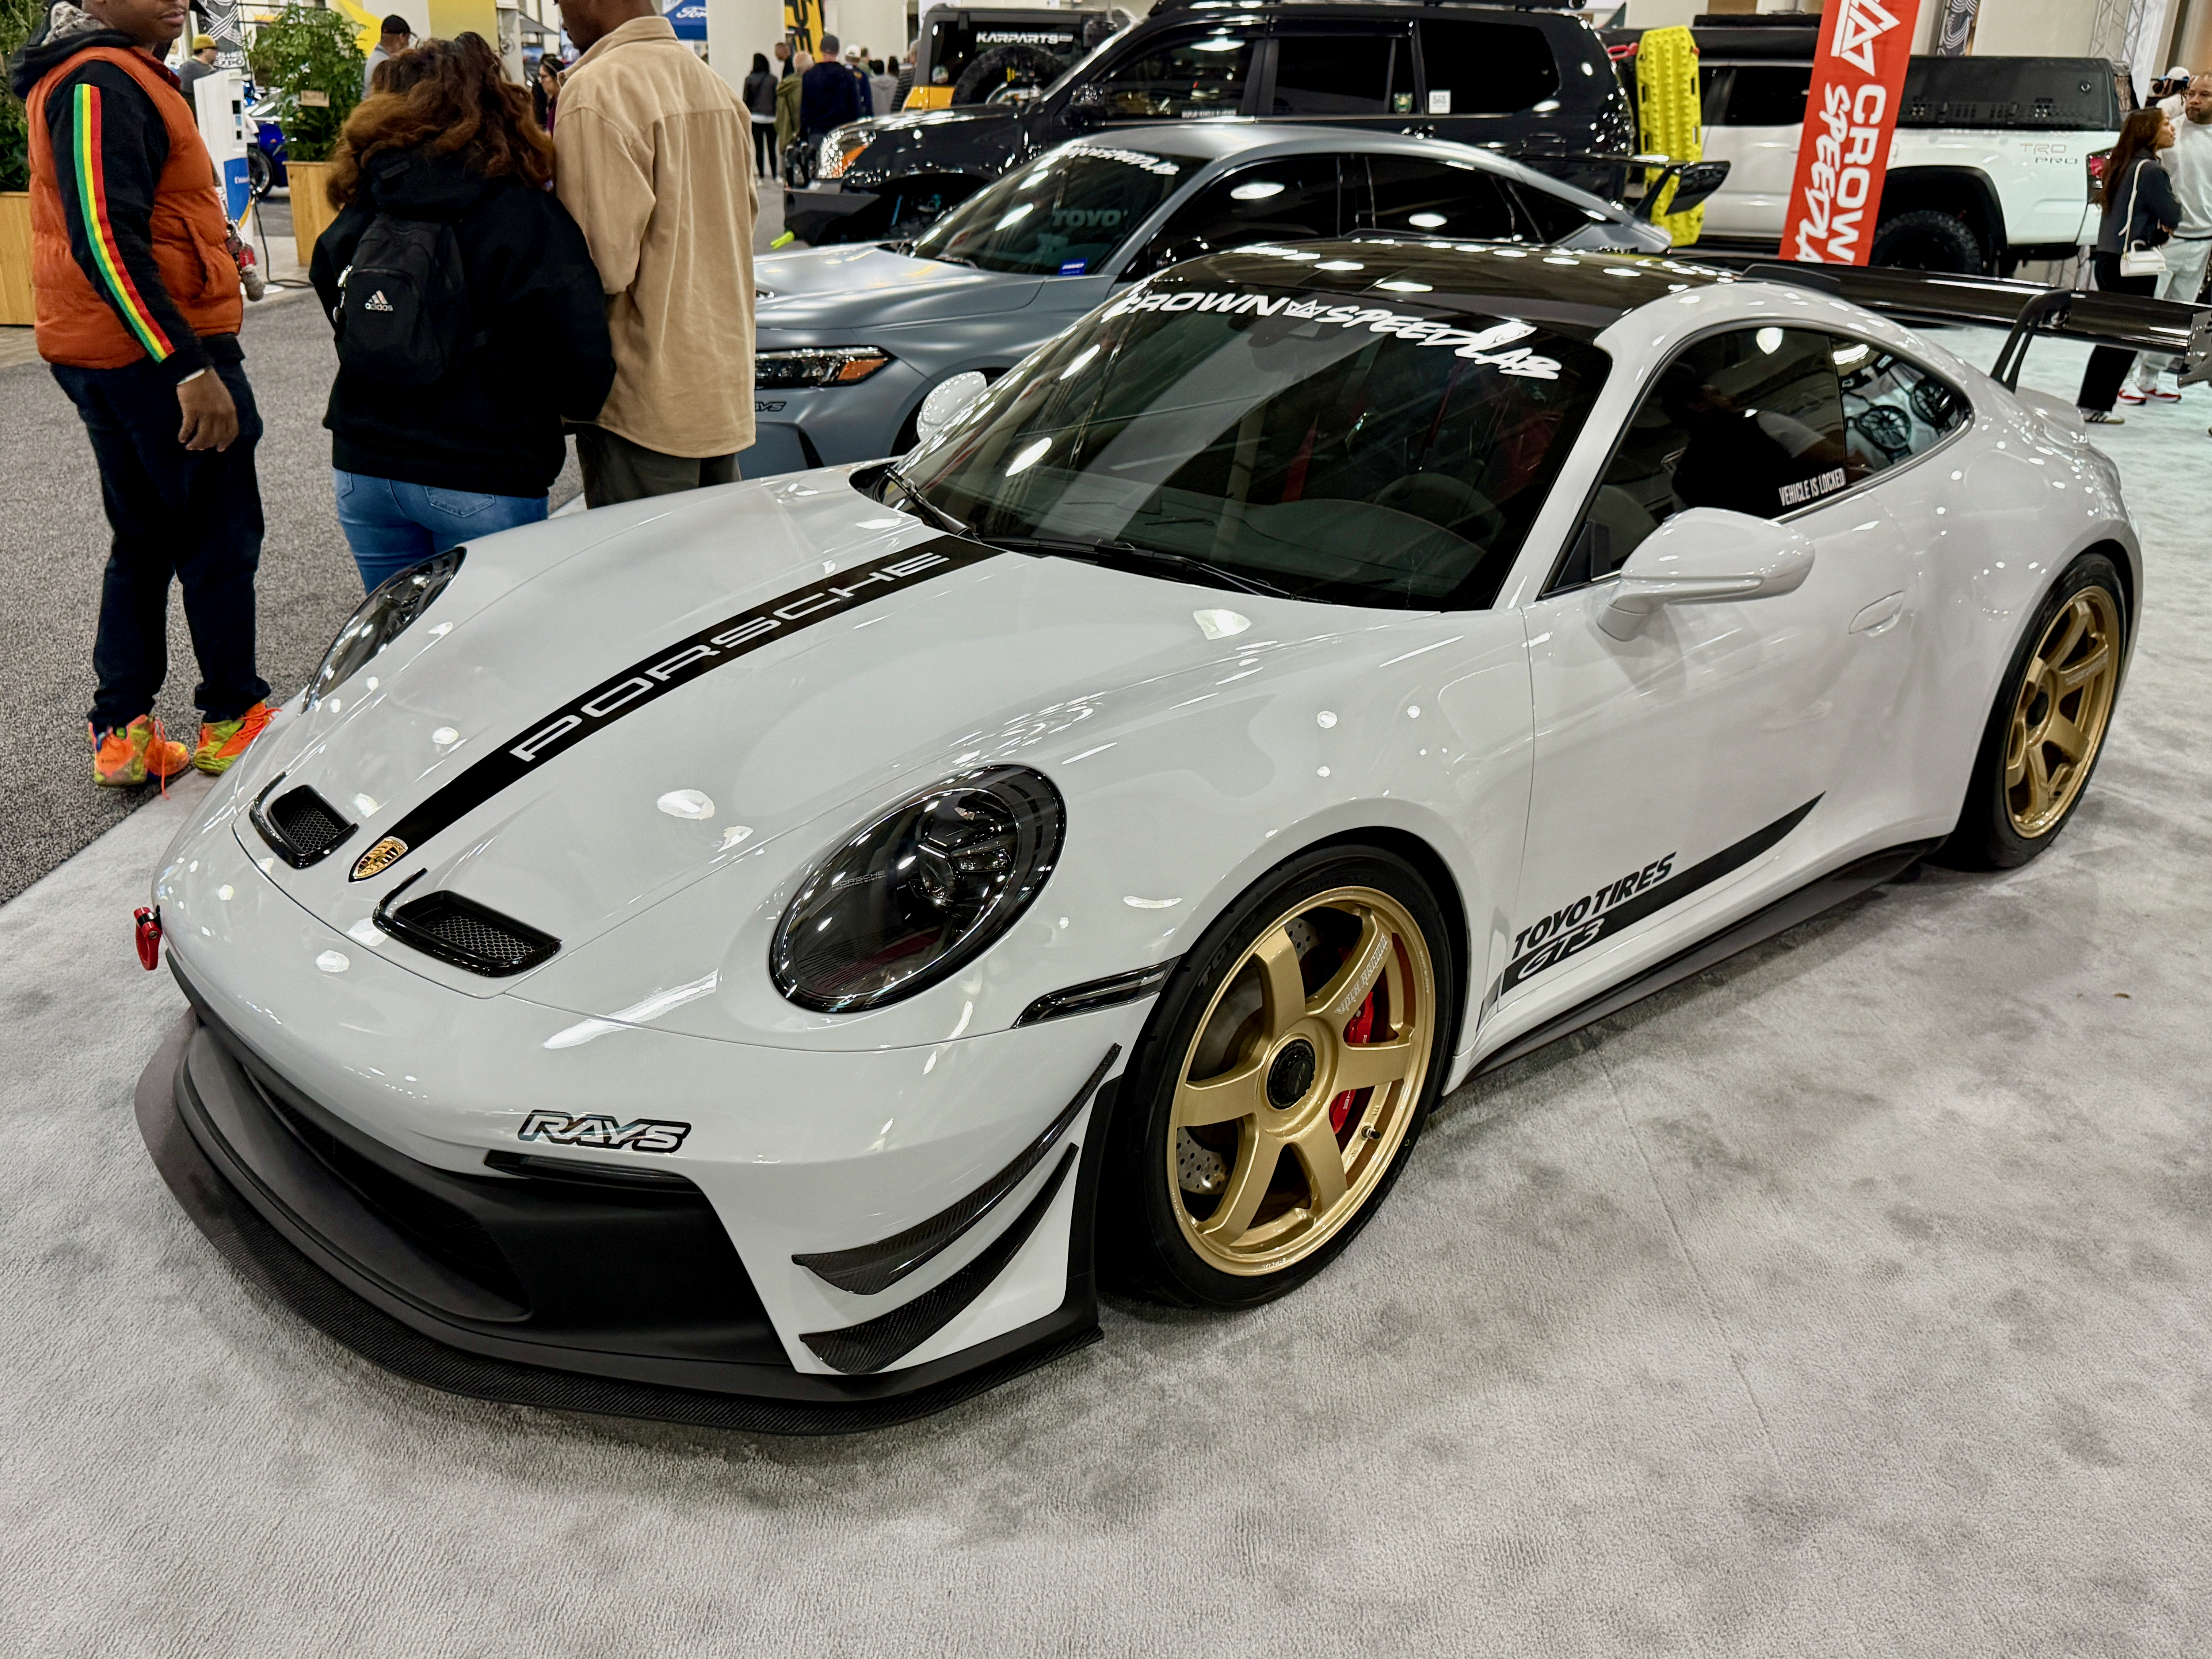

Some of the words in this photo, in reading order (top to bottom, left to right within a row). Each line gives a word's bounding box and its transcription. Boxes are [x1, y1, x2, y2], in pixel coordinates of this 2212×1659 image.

[976, 31, 1059, 45] KARPARTS
[1827, 84, 1887, 266] CROW
[1778, 480, 1811, 507] VEHICLE
[1810, 476, 1819, 498] IS
[1818, 467, 1846, 495] LOCKED
[509, 552, 950, 763] PORSCHE
[831, 870, 886, 888] PORSCHE
[1511, 895, 1592, 961] TOYO
[1591, 850, 1677, 916] TIRES
[1517, 917, 1606, 979] GT3
[517, 1109, 692, 1153] RAYS
